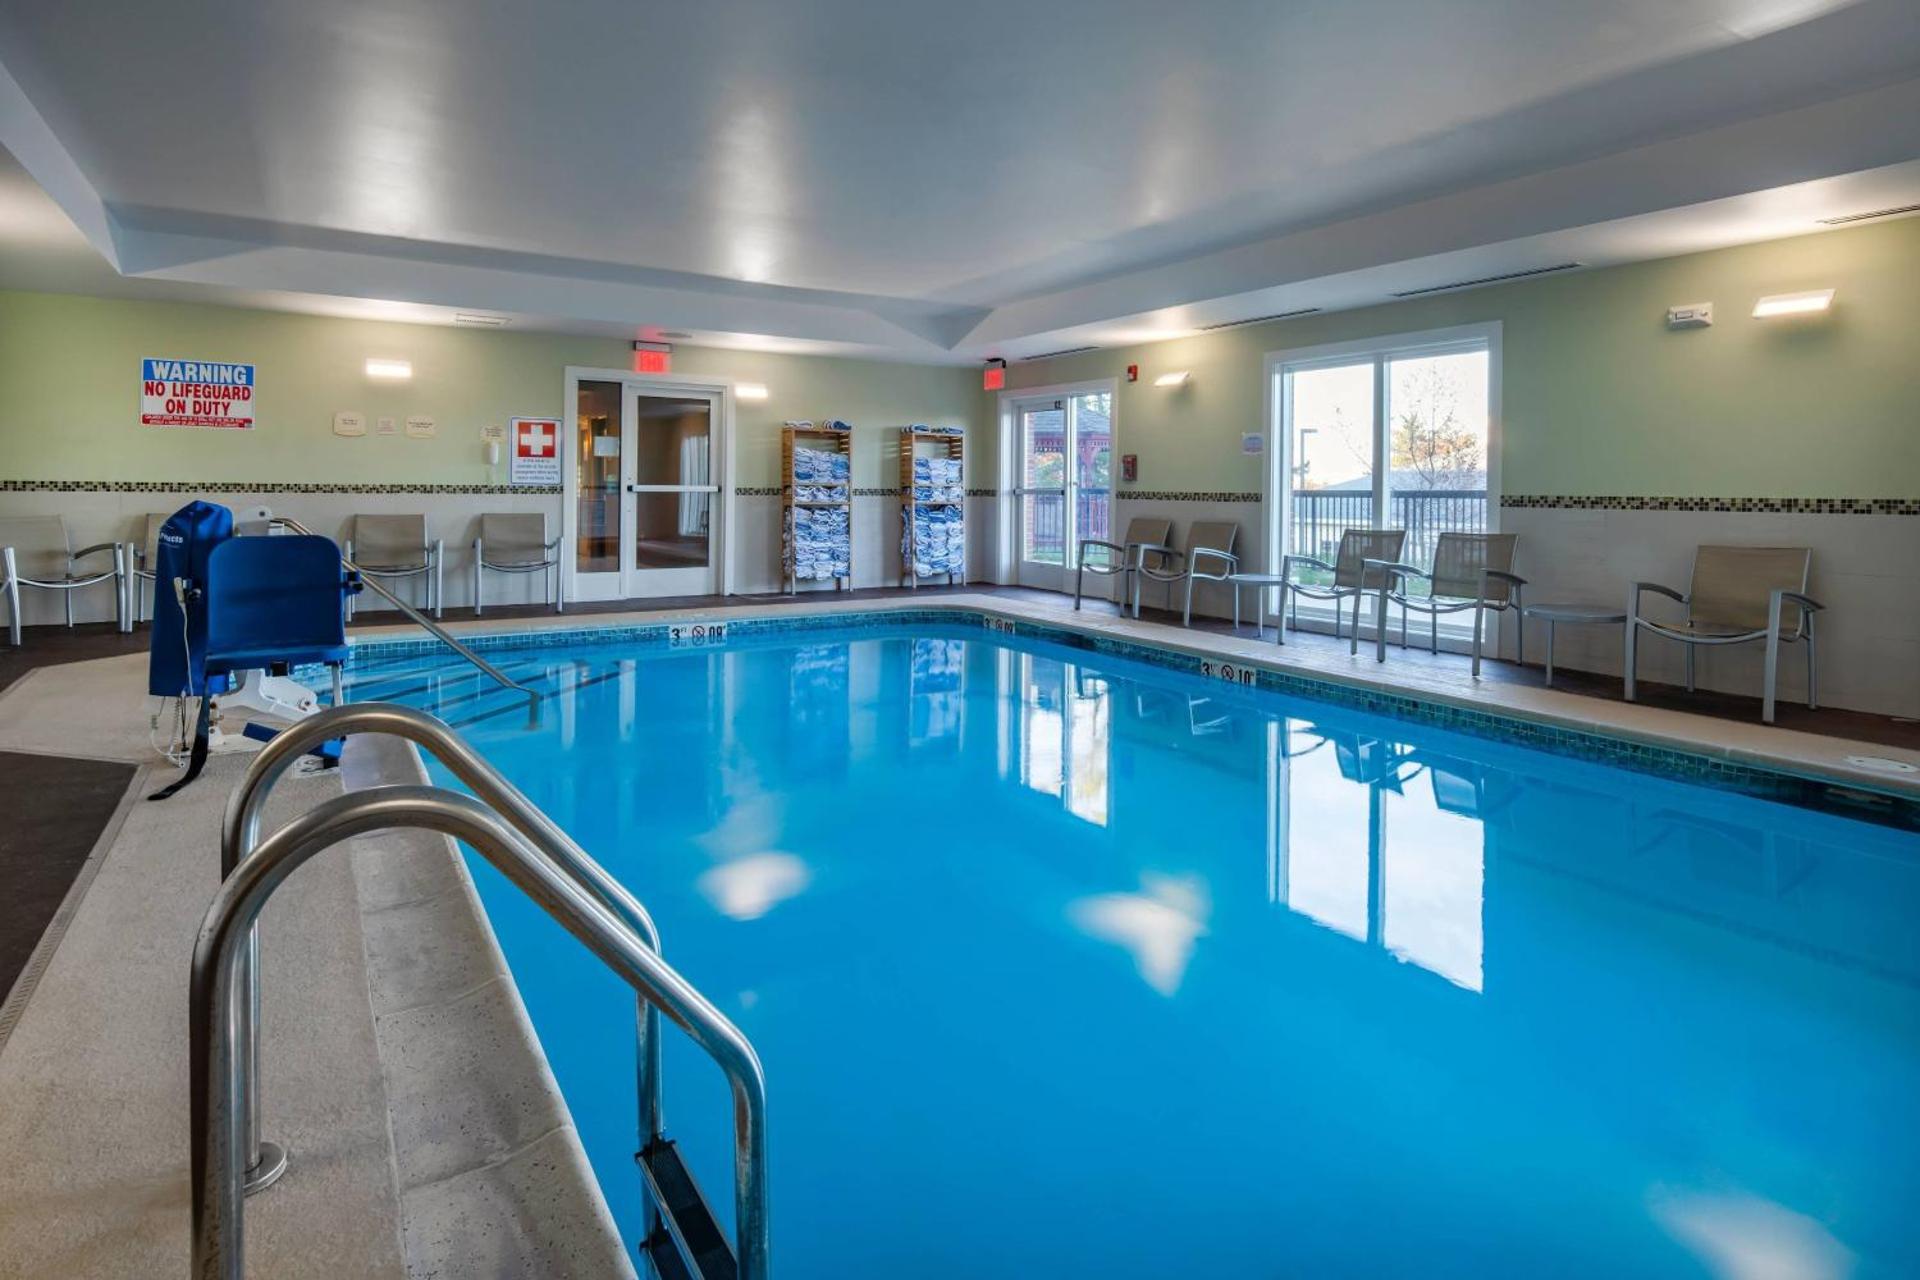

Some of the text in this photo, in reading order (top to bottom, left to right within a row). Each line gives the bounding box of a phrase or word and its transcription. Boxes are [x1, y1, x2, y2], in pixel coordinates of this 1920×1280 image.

[152, 361, 246, 384] WARNING
[144, 382, 251, 401] NO LIFEGUARD
[166, 399, 231, 416] ON DUTY
